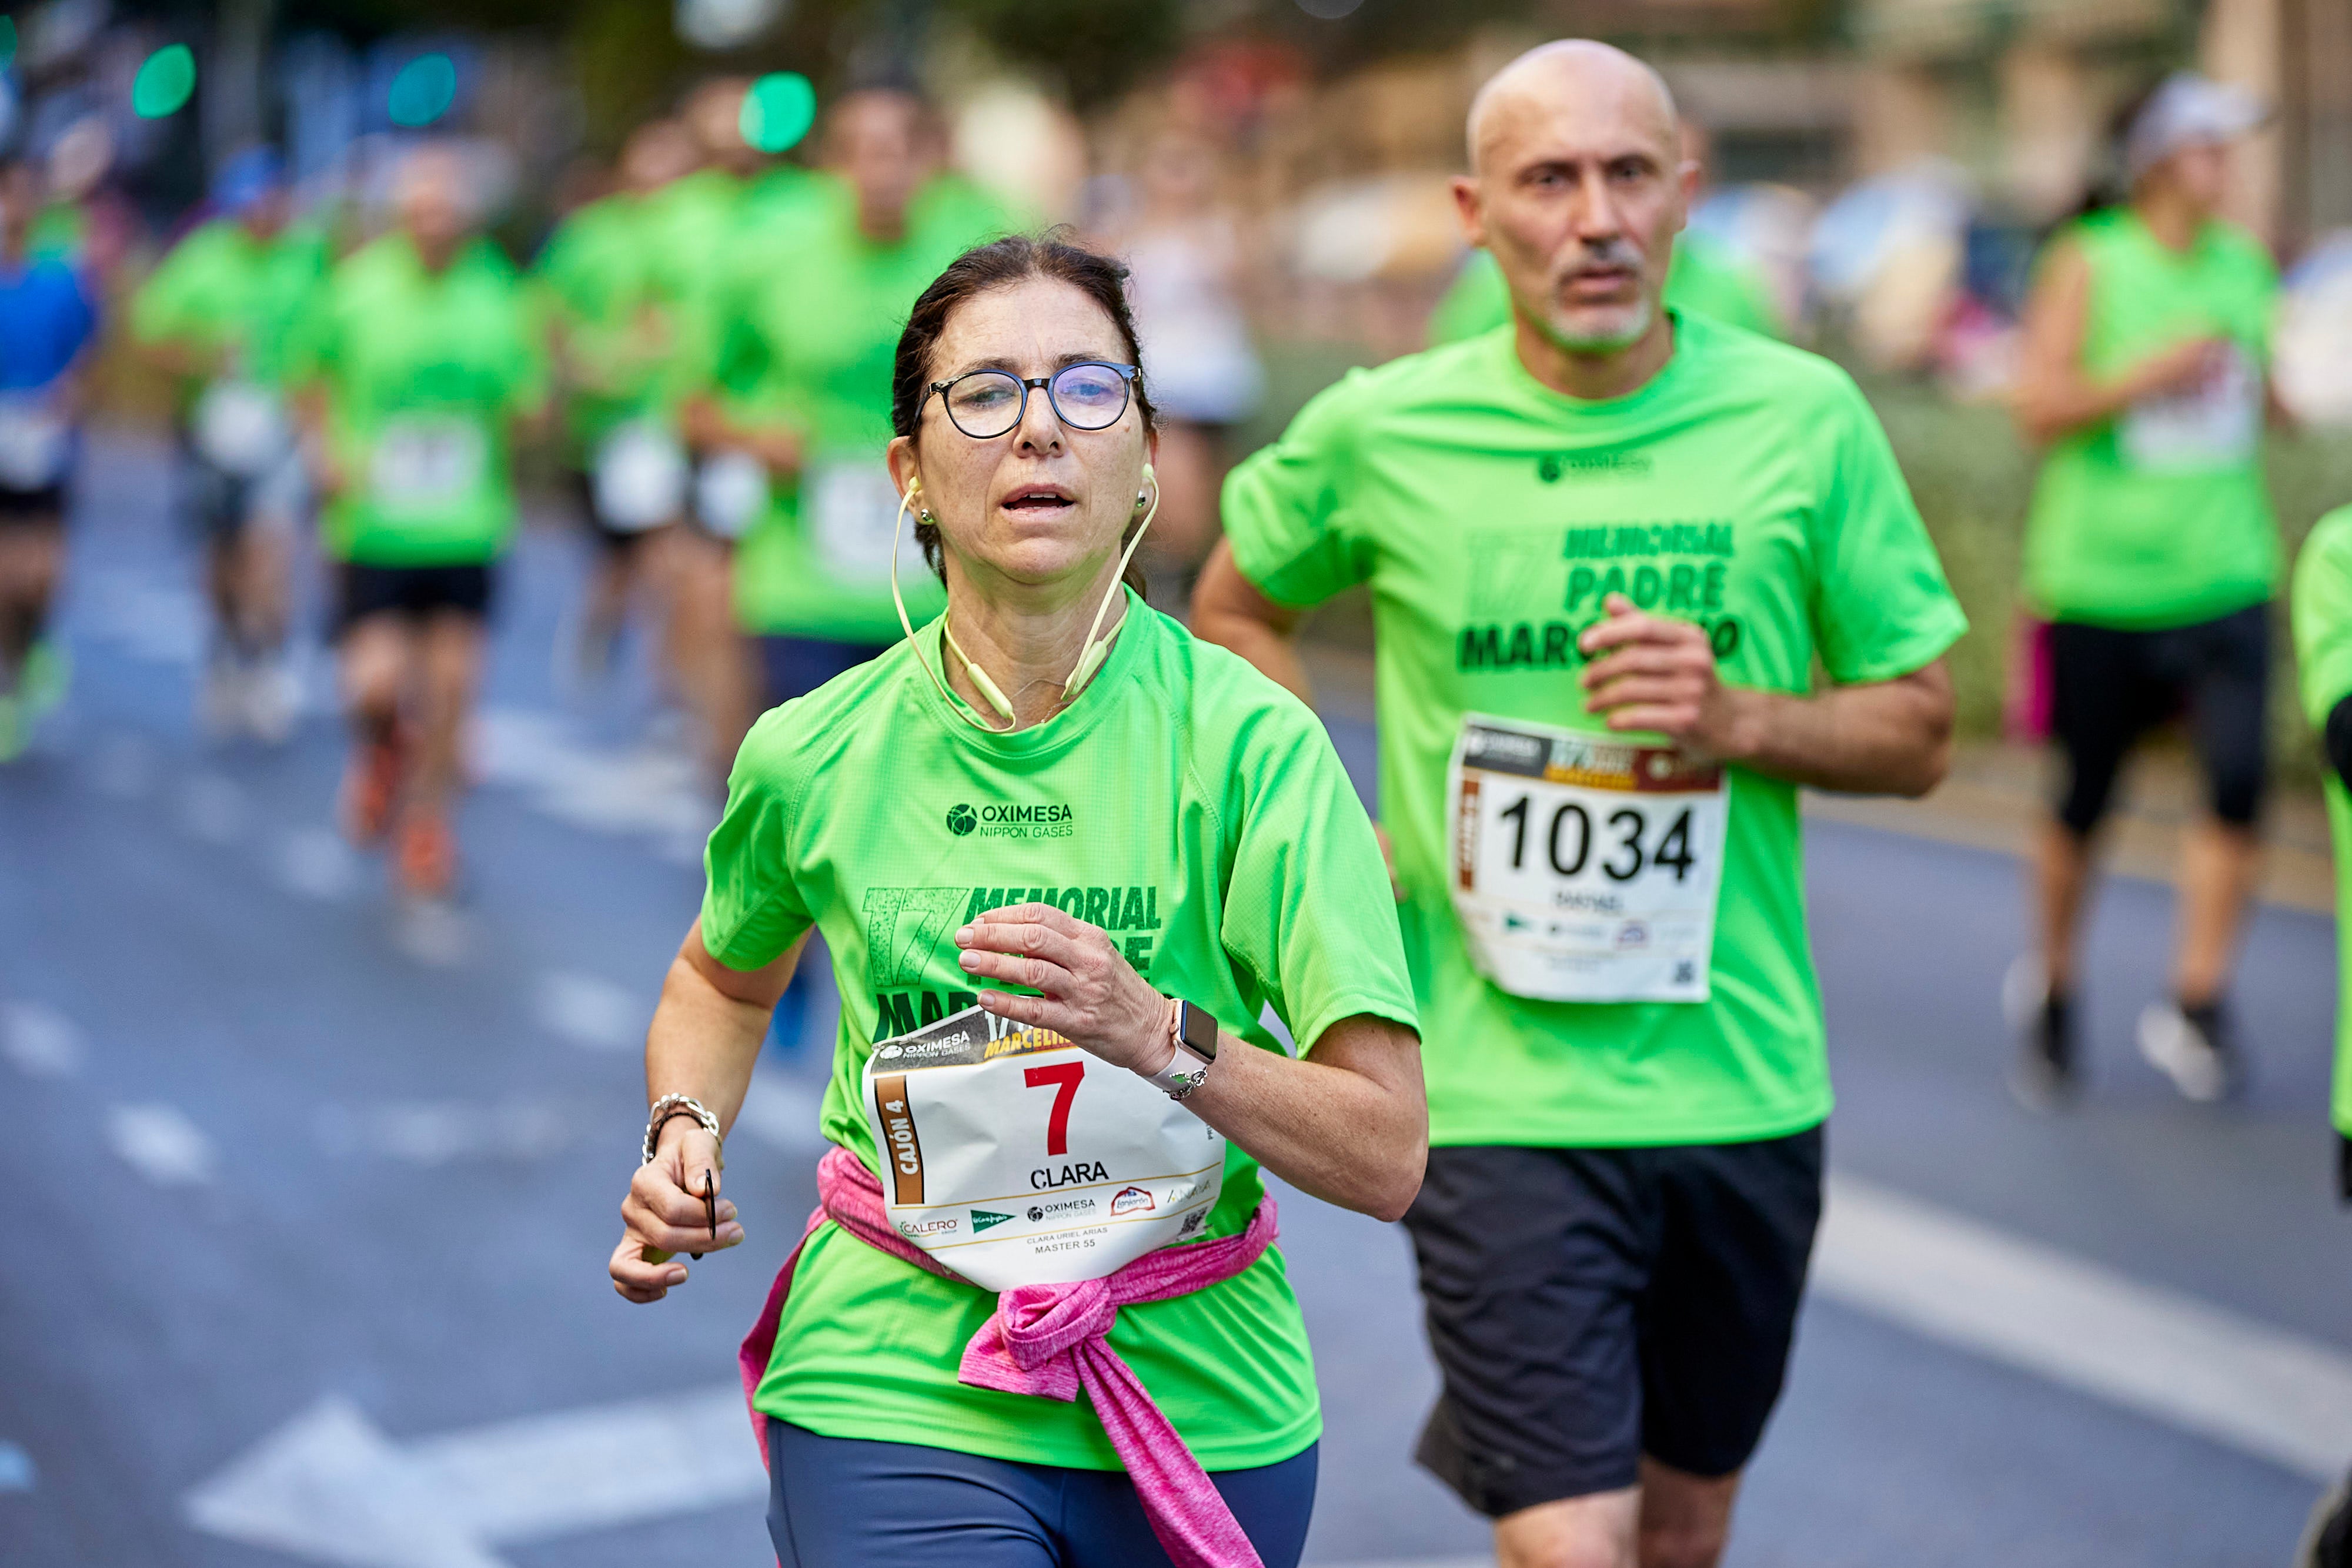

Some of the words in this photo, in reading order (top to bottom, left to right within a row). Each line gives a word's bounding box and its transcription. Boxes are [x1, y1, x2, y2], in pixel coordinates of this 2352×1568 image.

[1563, 563, 1727, 612] PADRE
[982, 804, 1073, 823] OXIMESA
[980, 826, 1028, 838] NIPPON
[1033, 825, 1073, 838] GASES
[1502, 796, 1693, 881] 1034
[862, 887, 970, 988] 17
[905, 1030, 970, 1054] OXIMESA
[903, 1050, 939, 1059] NIPPON
[886, 1099, 904, 1113] 4
[1024, 1061, 1085, 1156] 7
[889, 1118, 918, 1175] CAJÓN
[1031, 1161, 1109, 1189] CLARA
[1045, 1199, 1095, 1213] OXIMESA
[904, 1219, 957, 1233] CALERO
[1027, 1235, 1054, 1244] CLARA
[1057, 1231, 1081, 1240] URIEL
[1083, 1227, 1108, 1236] ARIAS
[1035, 1241, 1080, 1254] MASTER
[1084, 1239, 1095, 1248] 55
